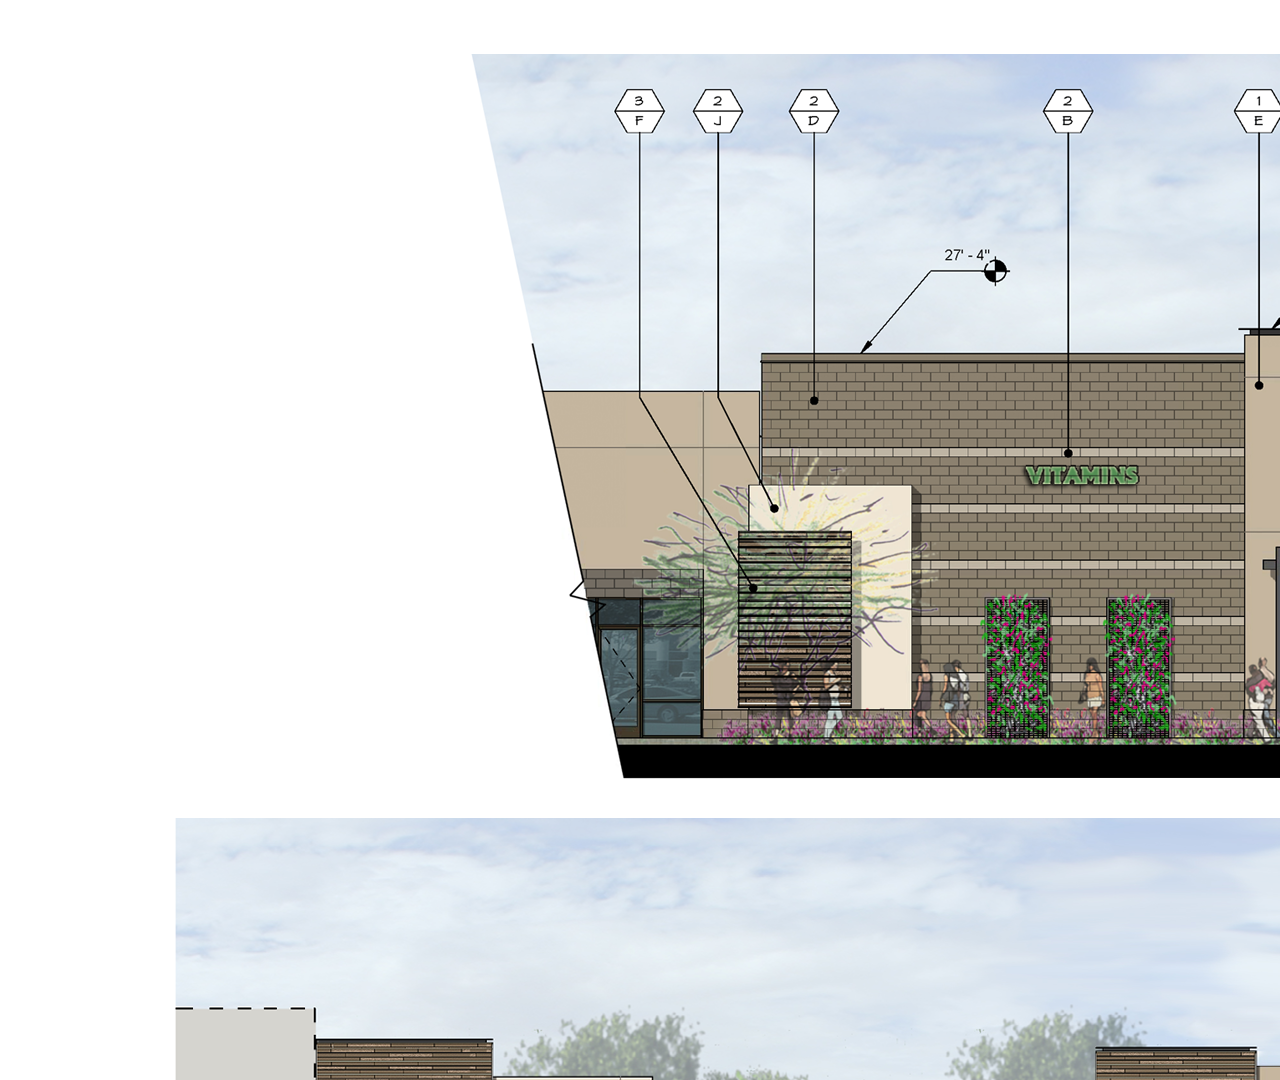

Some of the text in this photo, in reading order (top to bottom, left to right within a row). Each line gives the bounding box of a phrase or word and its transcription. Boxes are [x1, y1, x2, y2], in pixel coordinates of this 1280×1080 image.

[634, 95, 644, 107] 3
[713, 95, 723, 107] 2
[809, 95, 819, 107] 2
[1063, 95, 1073, 107] 2
[635, 115, 644, 126] F
[713, 115, 722, 126] J
[808, 115, 820, 126] D
[1062, 115, 1074, 126] B
[1254, 115, 1264, 126] E
[944, 248, 964, 261] 27'
[1025, 465, 1140, 485] VITAMINS
